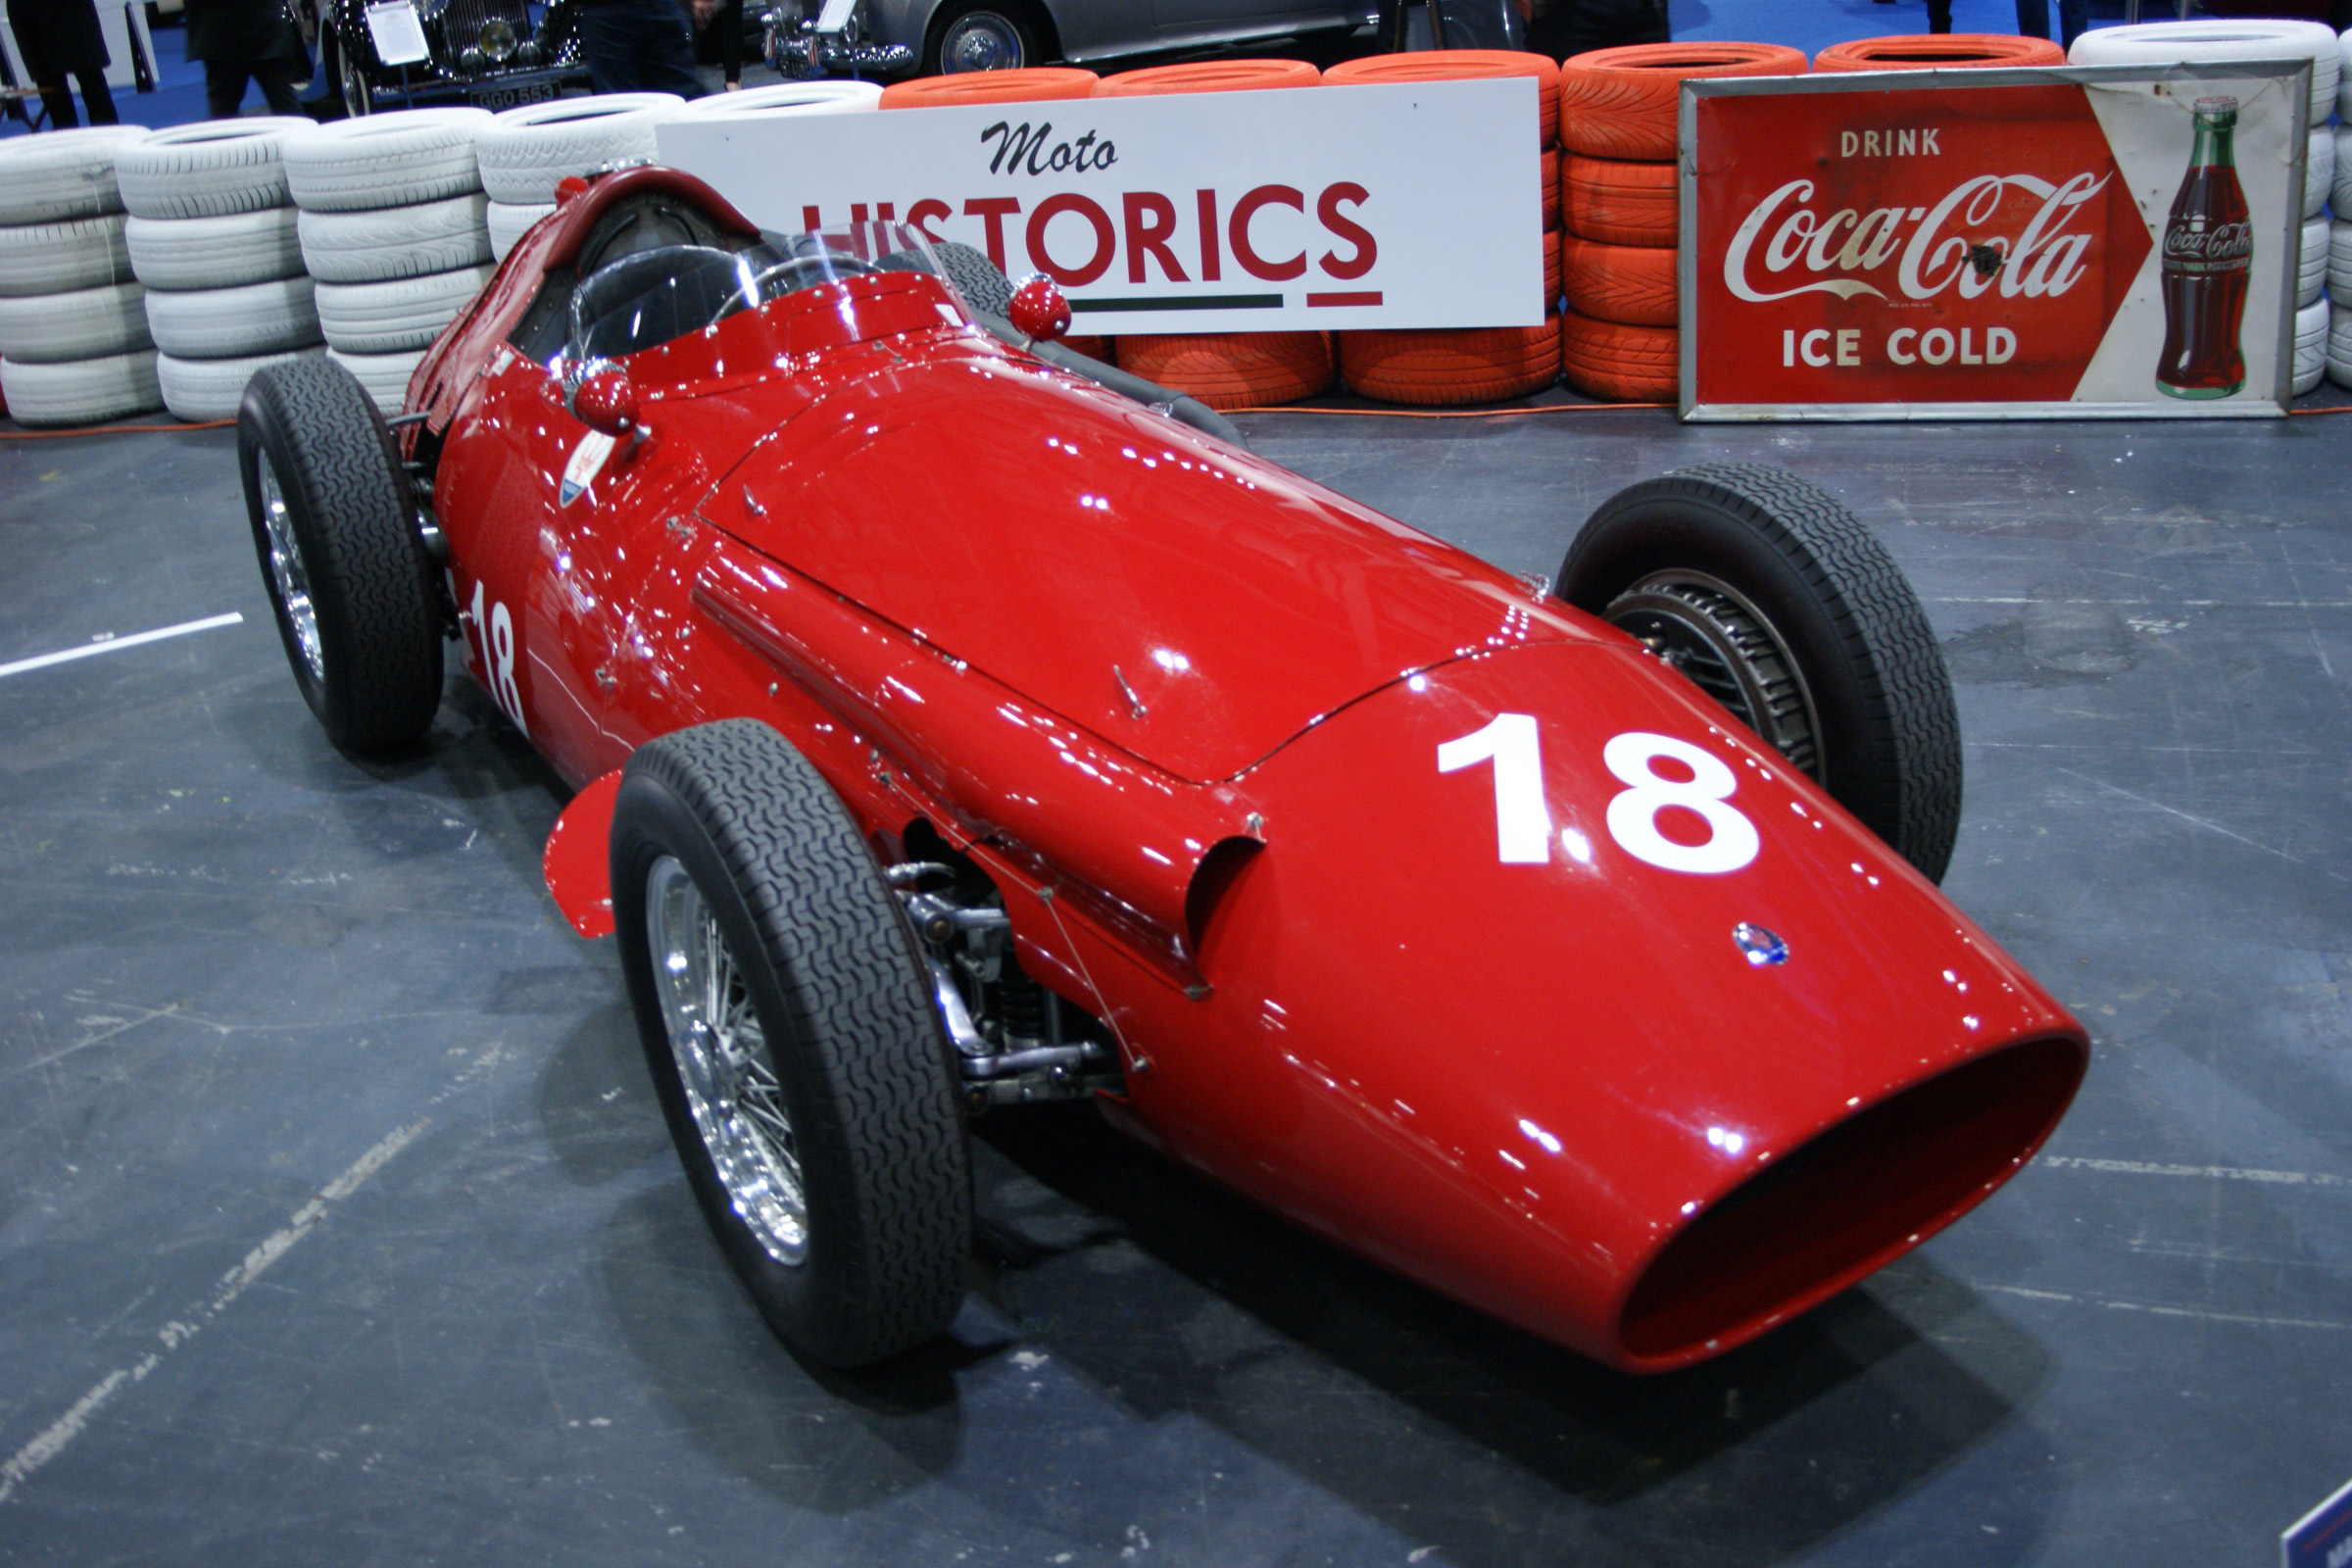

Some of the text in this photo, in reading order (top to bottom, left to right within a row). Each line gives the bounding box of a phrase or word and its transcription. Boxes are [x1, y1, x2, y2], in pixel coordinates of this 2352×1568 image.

[518, 84, 555, 104] 553
[980, 120, 1119, 176] Moto
[1840, 128, 1941, 158] DRINK
[1723, 170, 2115, 303] Coca-Cola
[2164, 220, 2252, 260] Coca-Cola
[1783, 326, 2018, 368] ICE COLD
[470, 578, 531, 740] 18
[1437, 711, 1761, 874] 18
